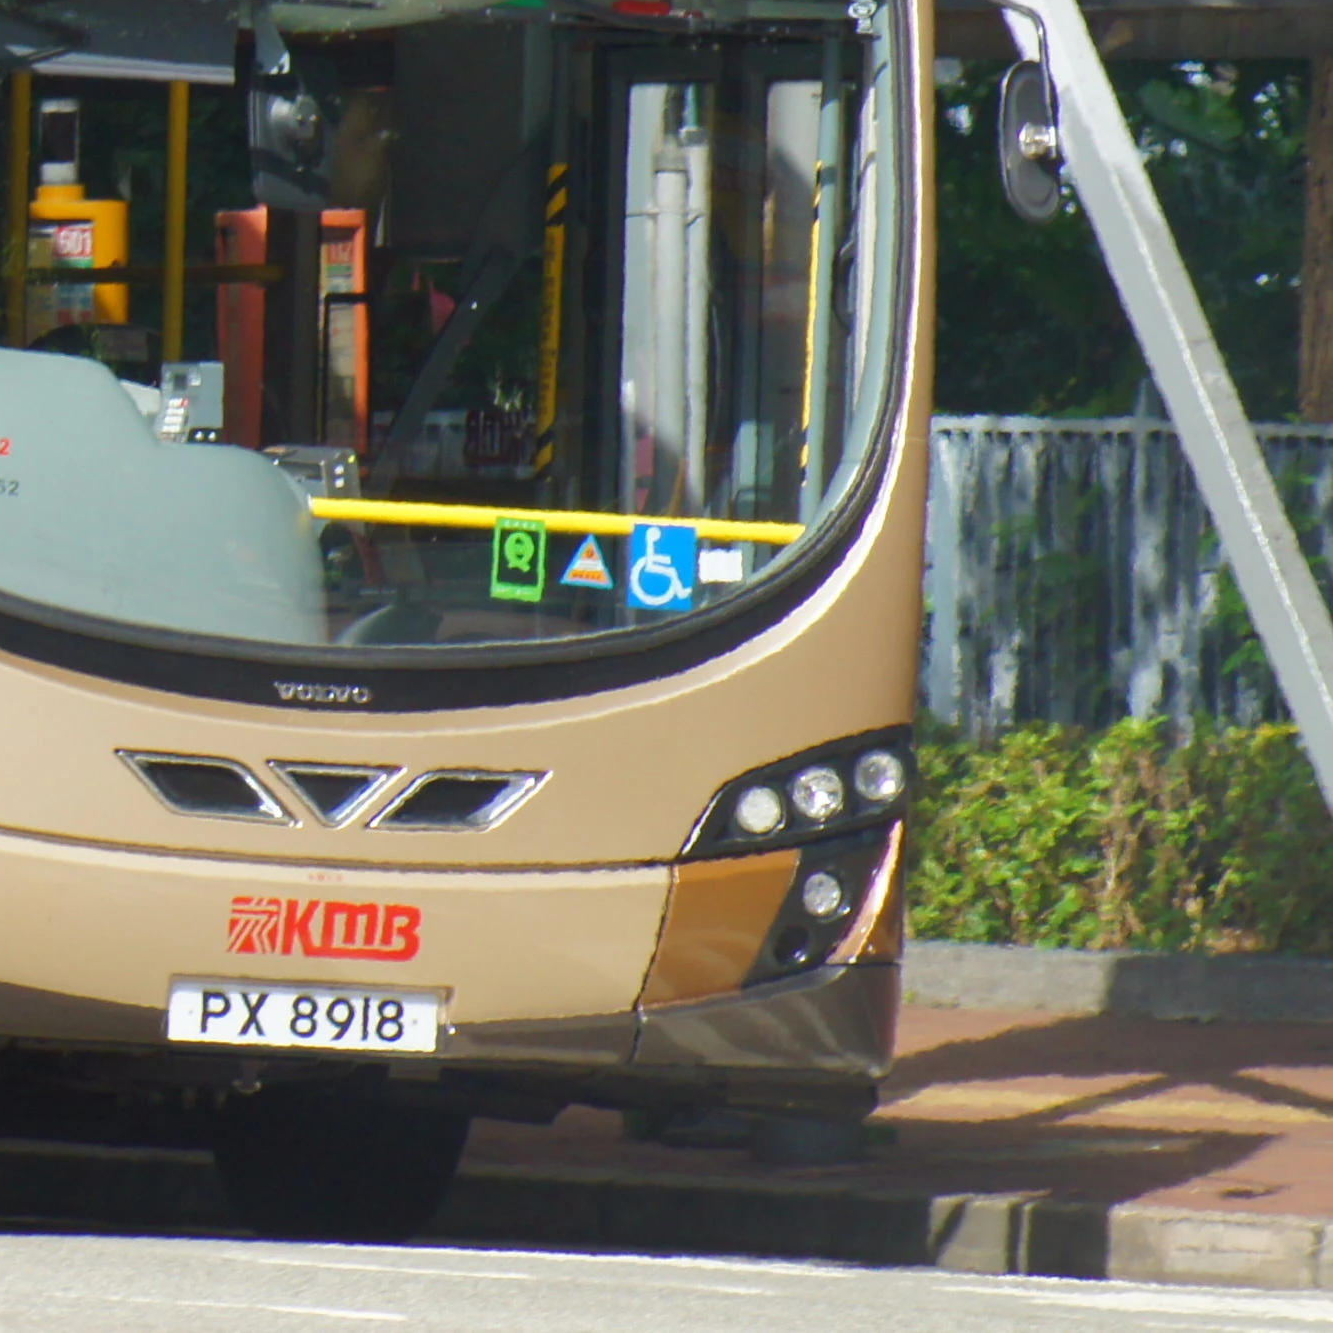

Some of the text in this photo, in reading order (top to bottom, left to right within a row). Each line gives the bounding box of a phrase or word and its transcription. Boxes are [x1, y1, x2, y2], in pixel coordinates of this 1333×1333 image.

[273, 681, 371, 704] VOLVO
[281, 898, 421, 962] KMB
[200, 990, 404, 1043] PX 8918
